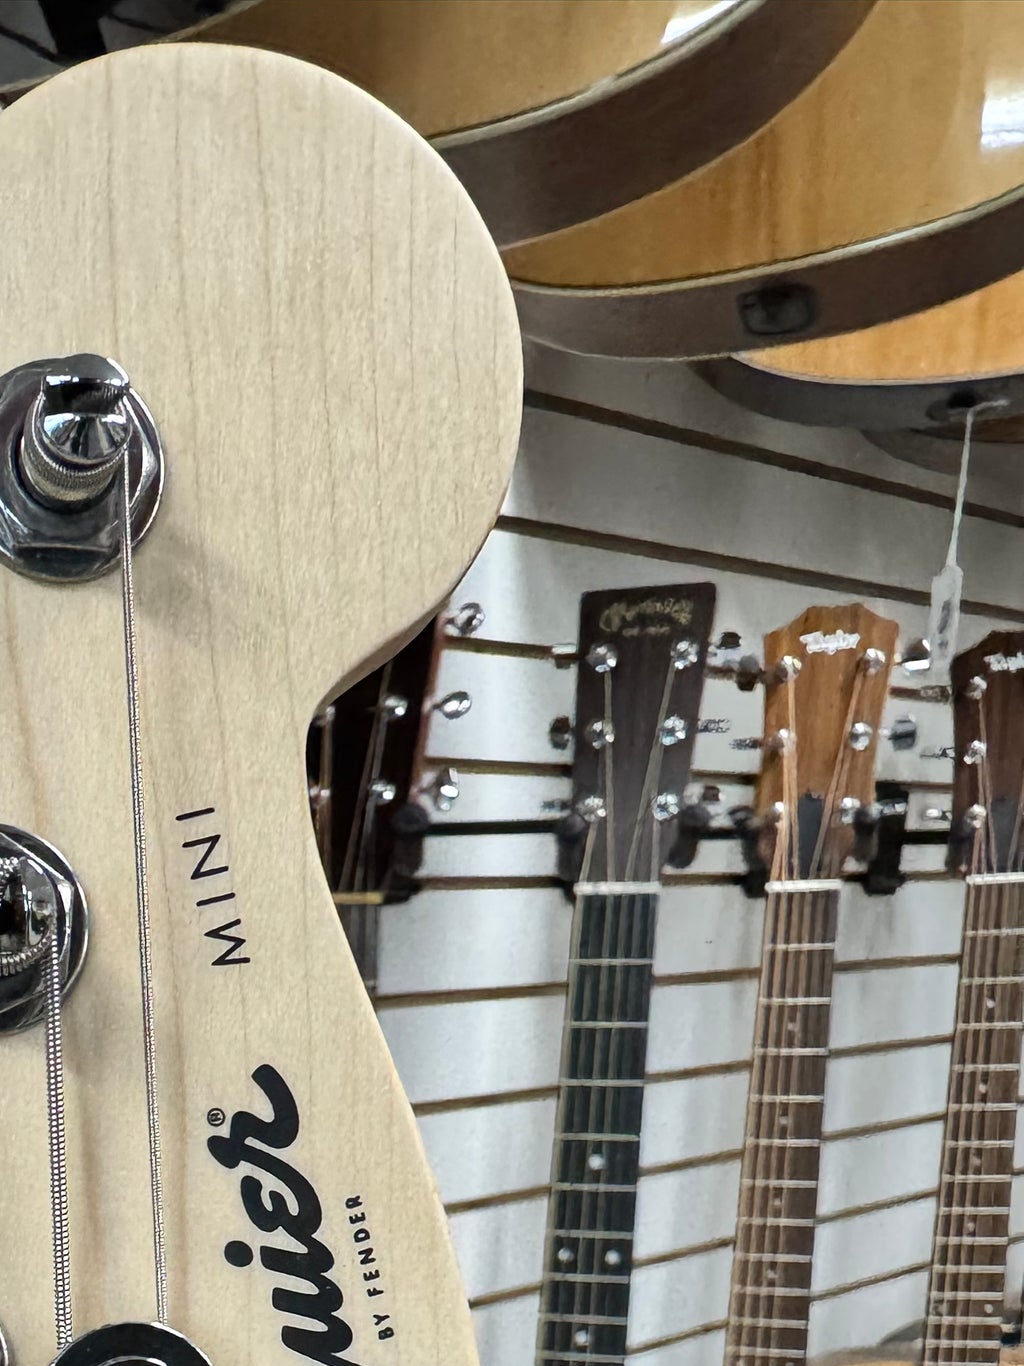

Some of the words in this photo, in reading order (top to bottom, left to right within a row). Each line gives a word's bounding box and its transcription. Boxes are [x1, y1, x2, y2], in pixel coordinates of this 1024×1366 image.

[175, 807, 251, 967] MINI
[345, 1195, 384, 1298] FENDER
[372, 1314, 395, 1341] BY
